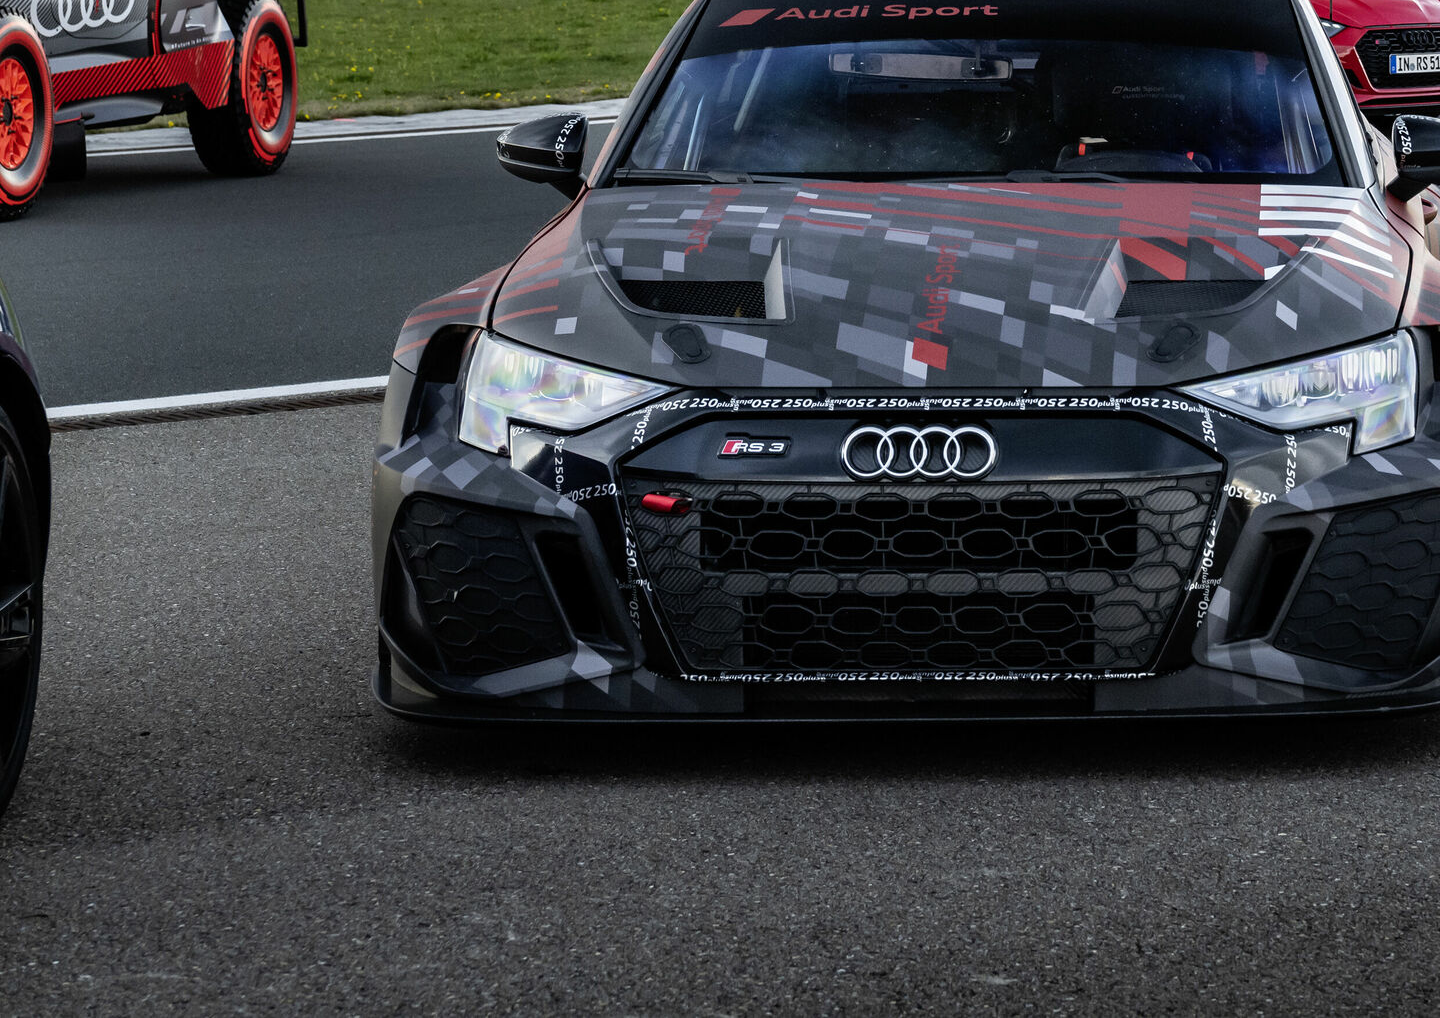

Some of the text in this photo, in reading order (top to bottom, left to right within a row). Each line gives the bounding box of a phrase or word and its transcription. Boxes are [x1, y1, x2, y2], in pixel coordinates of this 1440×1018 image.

[774, 4, 1000, 21] Audi Sport
[1397, 56, 1410, 72] IN
[1416, 55, 1428, 71] RS
[916, 242, 963, 334] Audi Sport
[731, 442, 785, 453] RS 3
